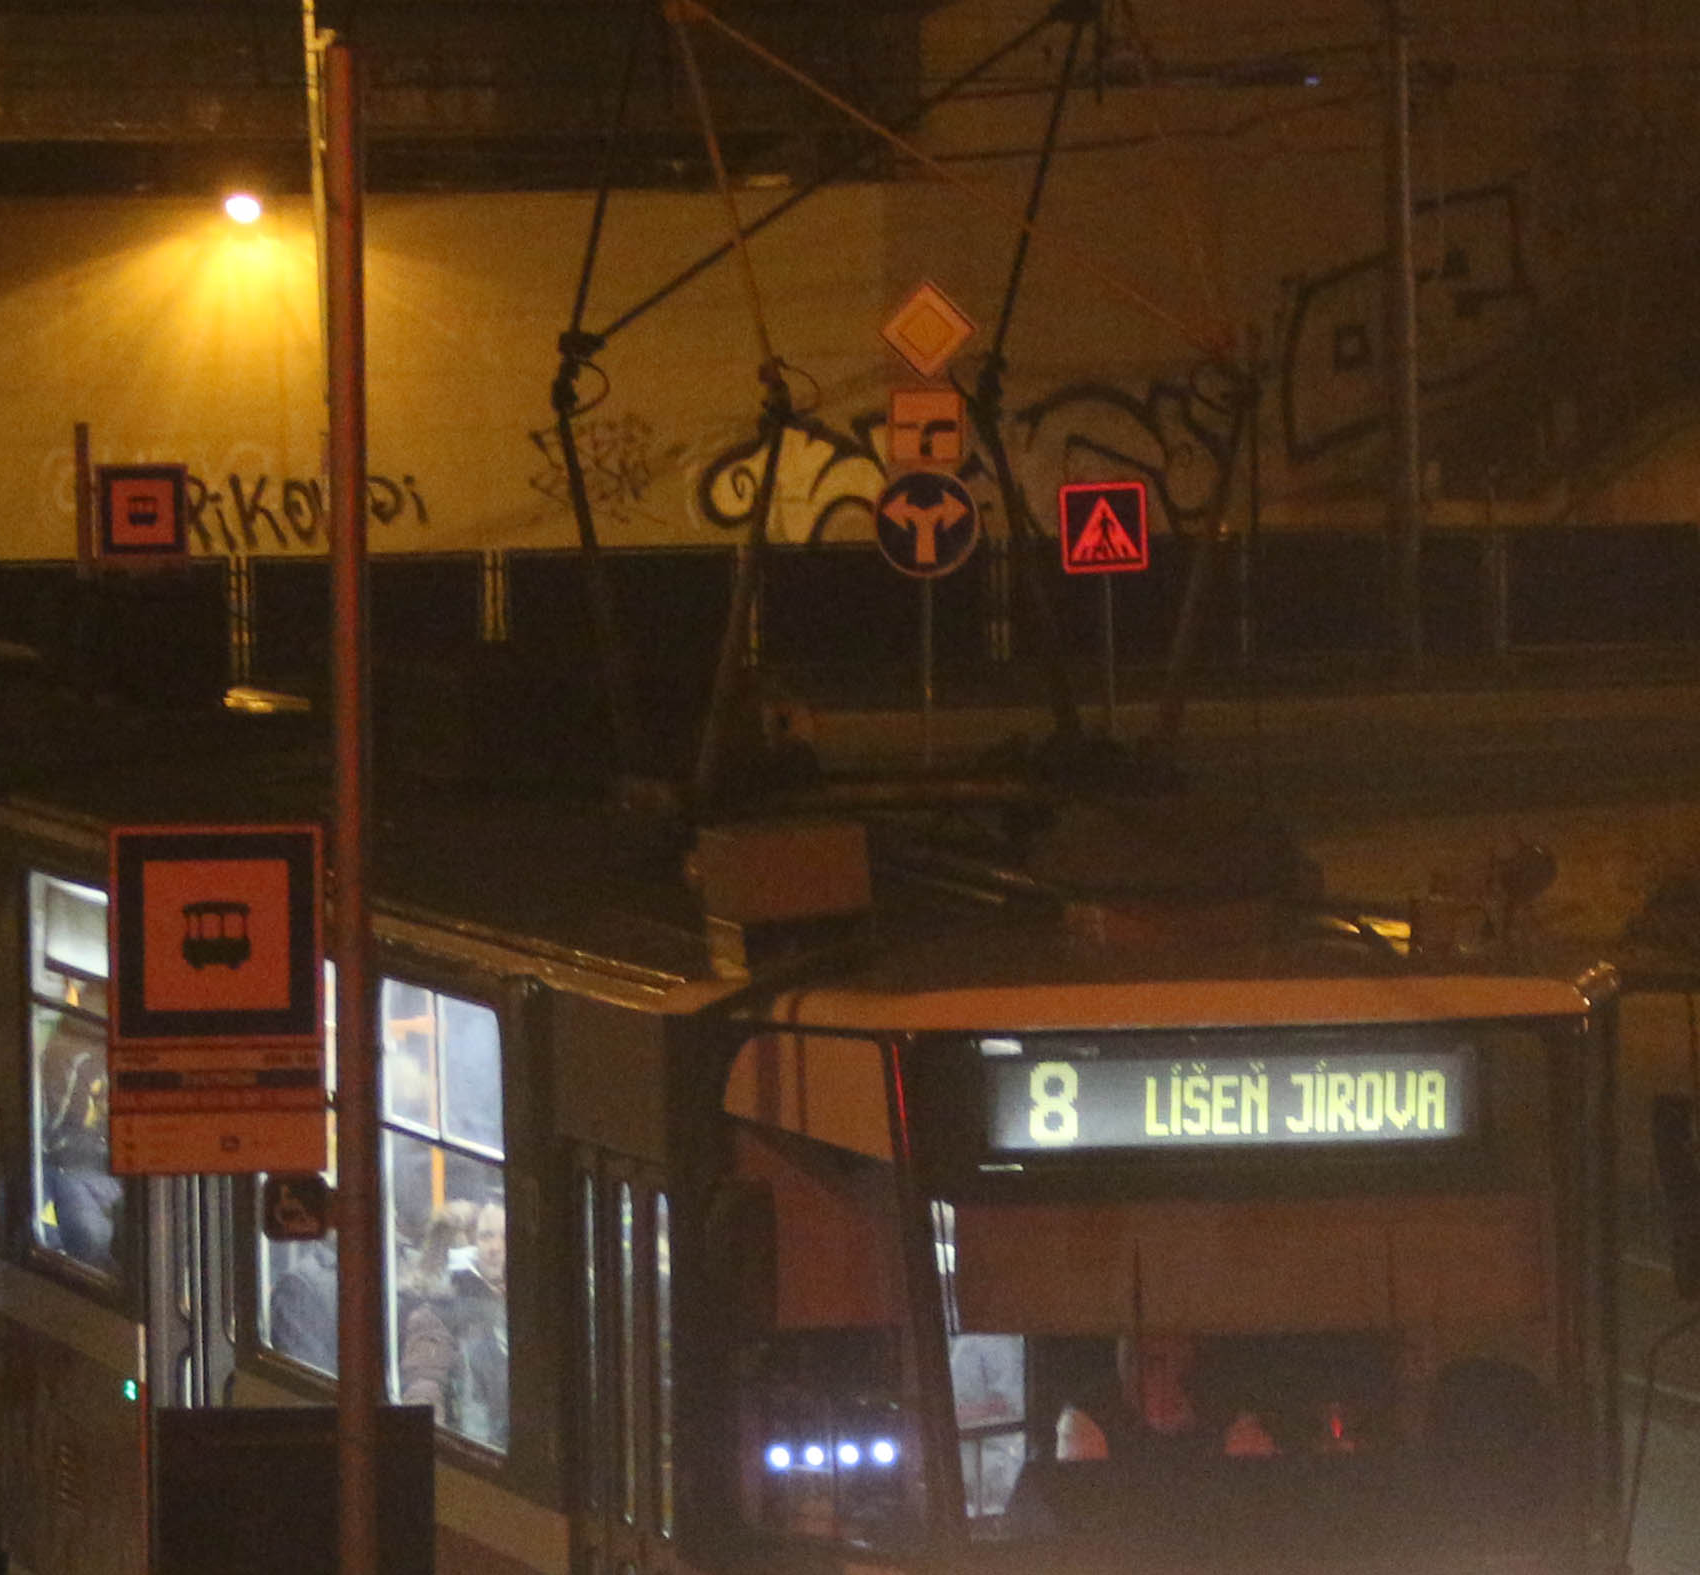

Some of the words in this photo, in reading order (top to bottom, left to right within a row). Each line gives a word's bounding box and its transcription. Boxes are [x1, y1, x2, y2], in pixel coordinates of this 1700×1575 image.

[1029, 1061, 1078, 1146] 8
[1145, 1061, 1269, 1136] LÍŠEŇ
[1286, 1059, 1446, 1134] JÍROVA
